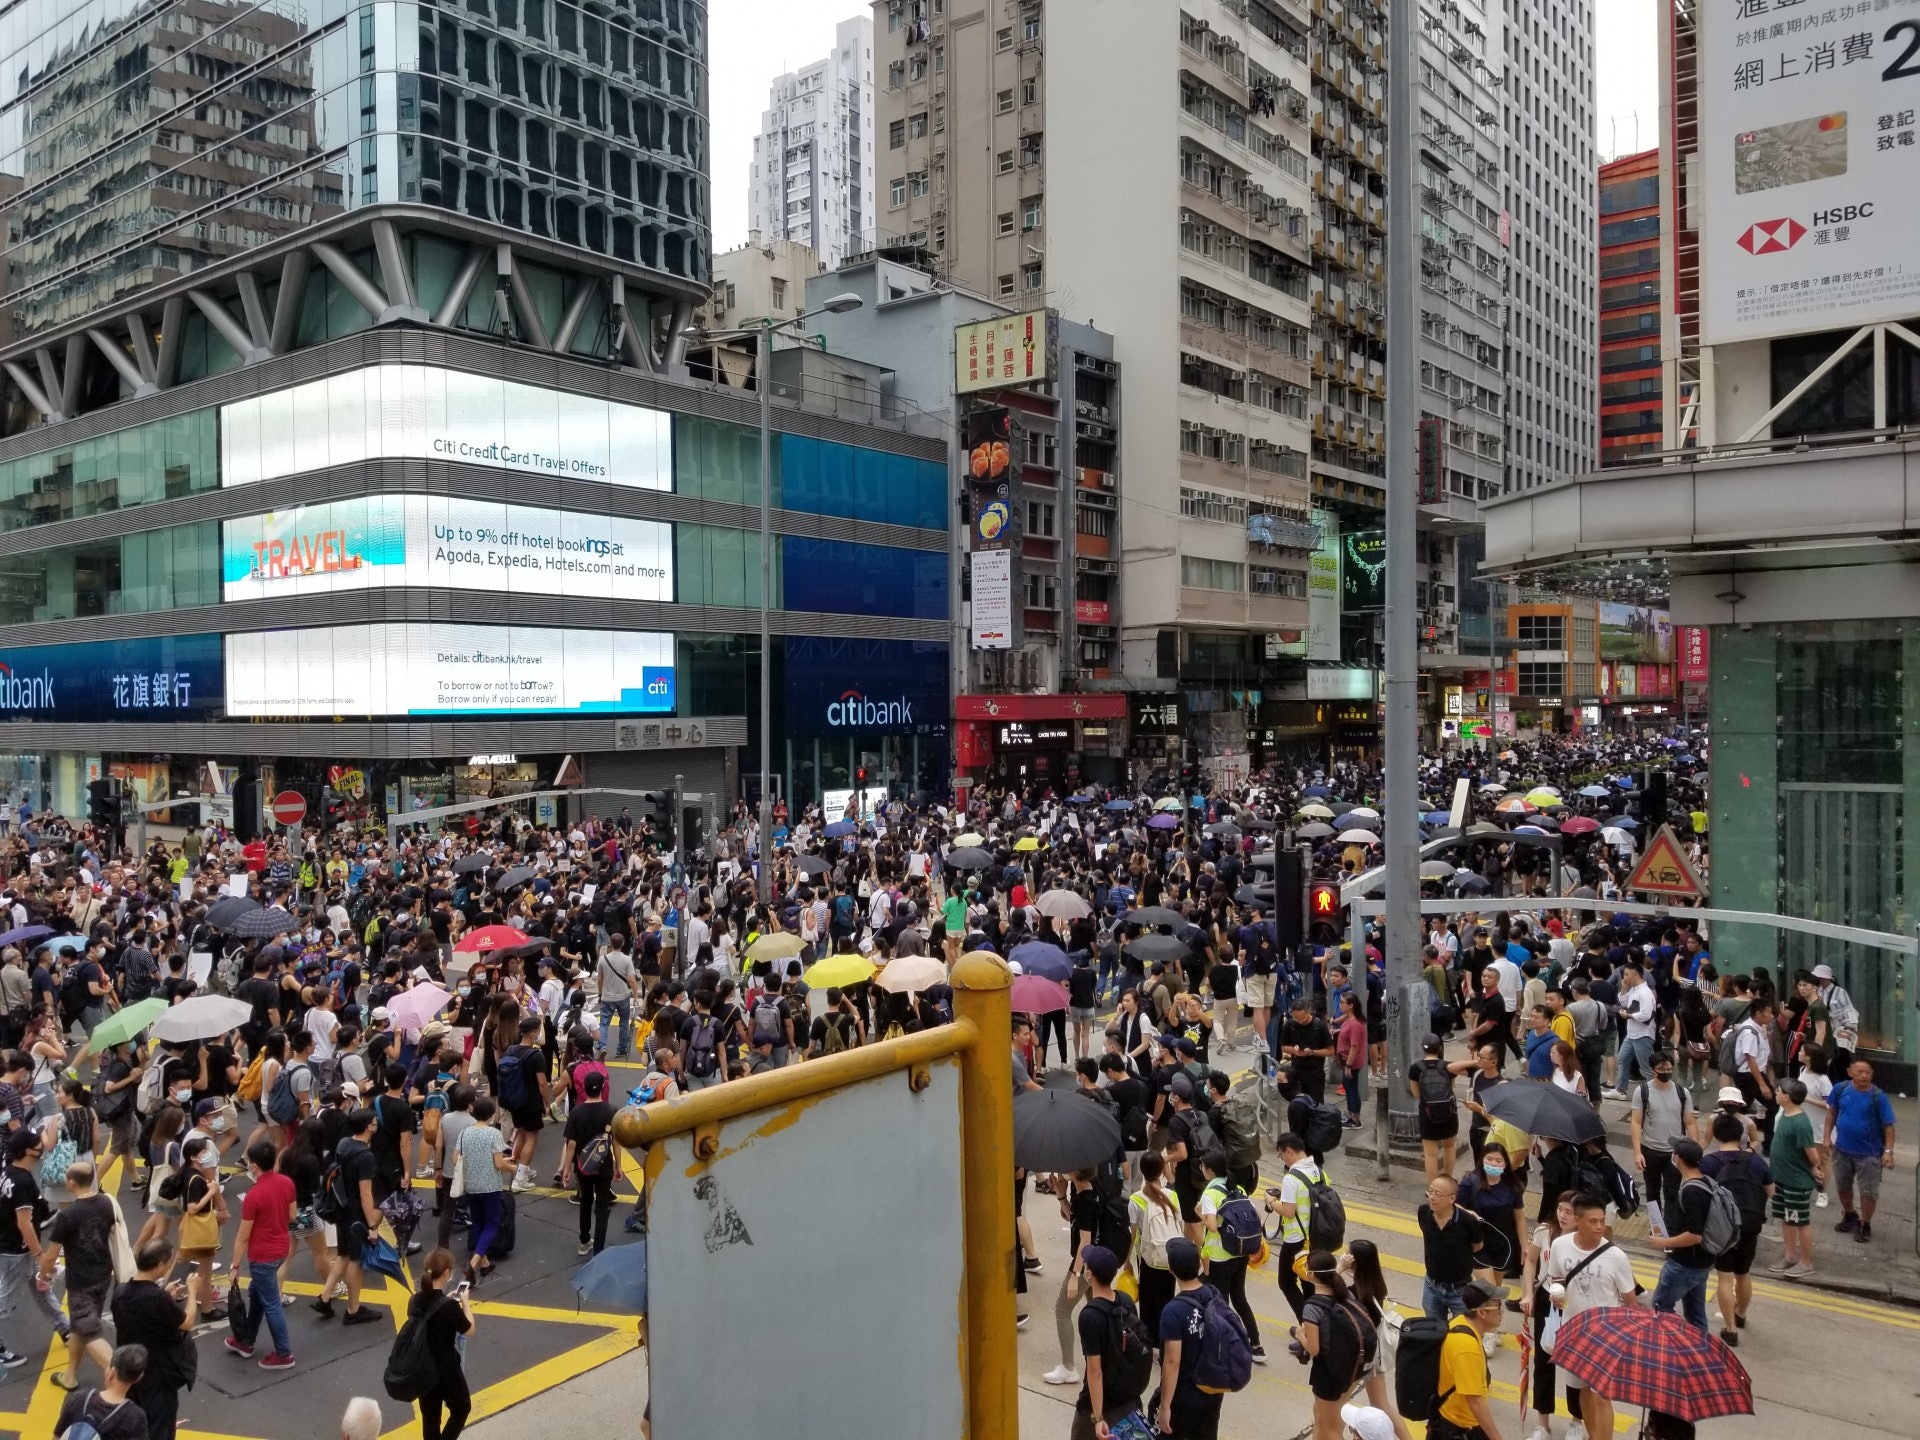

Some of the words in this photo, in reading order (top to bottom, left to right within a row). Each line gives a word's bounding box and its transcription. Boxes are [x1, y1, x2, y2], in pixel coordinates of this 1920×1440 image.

[1734, 31, 1874, 91] 網上消費
[1877, 109, 1915, 132] 登記
[1877, 129, 1915, 152] 致電
[1813, 202, 1874, 226] HSBC
[434, 439, 456, 454] Citi
[460, 442, 498, 460] Credit
[501, 446, 529, 464] Card
[533, 454, 569, 470] Travel
[572, 460, 605, 476] Offers
[435, 525, 454, 542] Up
[459, 527, 473, 541] to
[476, 528, 498, 544] 9%
[501, 532, 518, 546] off
[522, 533, 554, 549] hotel
[557, 536, 611, 558] bookings
[612, 543, 624, 556] at
[253, 530, 356, 577] TRAVEL
[435, 547, 484, 566] Agoda,
[488, 551, 542, 570] Expedia,
[545, 556, 611, 574] Hotels.com
[614, 563, 635, 576] and
[637, 566, 665, 578] more
[438, 653, 470, 663] Details:
[113, 672, 191, 709] 花旗銀行
[437, 681, 449, 690] To
[452, 681, 482, 690] borrow
[494, 681, 508, 690] not
[510, 681, 519, 690] to
[520, 680, 554, 690] borrow?
[648, 681, 668, 695] citi
[438, 694, 470, 703] Borrow
[472, 694, 489, 704] only
[492, 694, 498, 703] if
[500, 696, 514, 704] you
[532, 694, 557, 704] repay!
[827, 695, 913, 726] citibank
[1140, 704, 1178, 725] 六福
[339, 772, 360, 790] FINAL
[1785, 1207, 1799, 1223] 14
[1564, 1258, 1602, 1278] CLI
